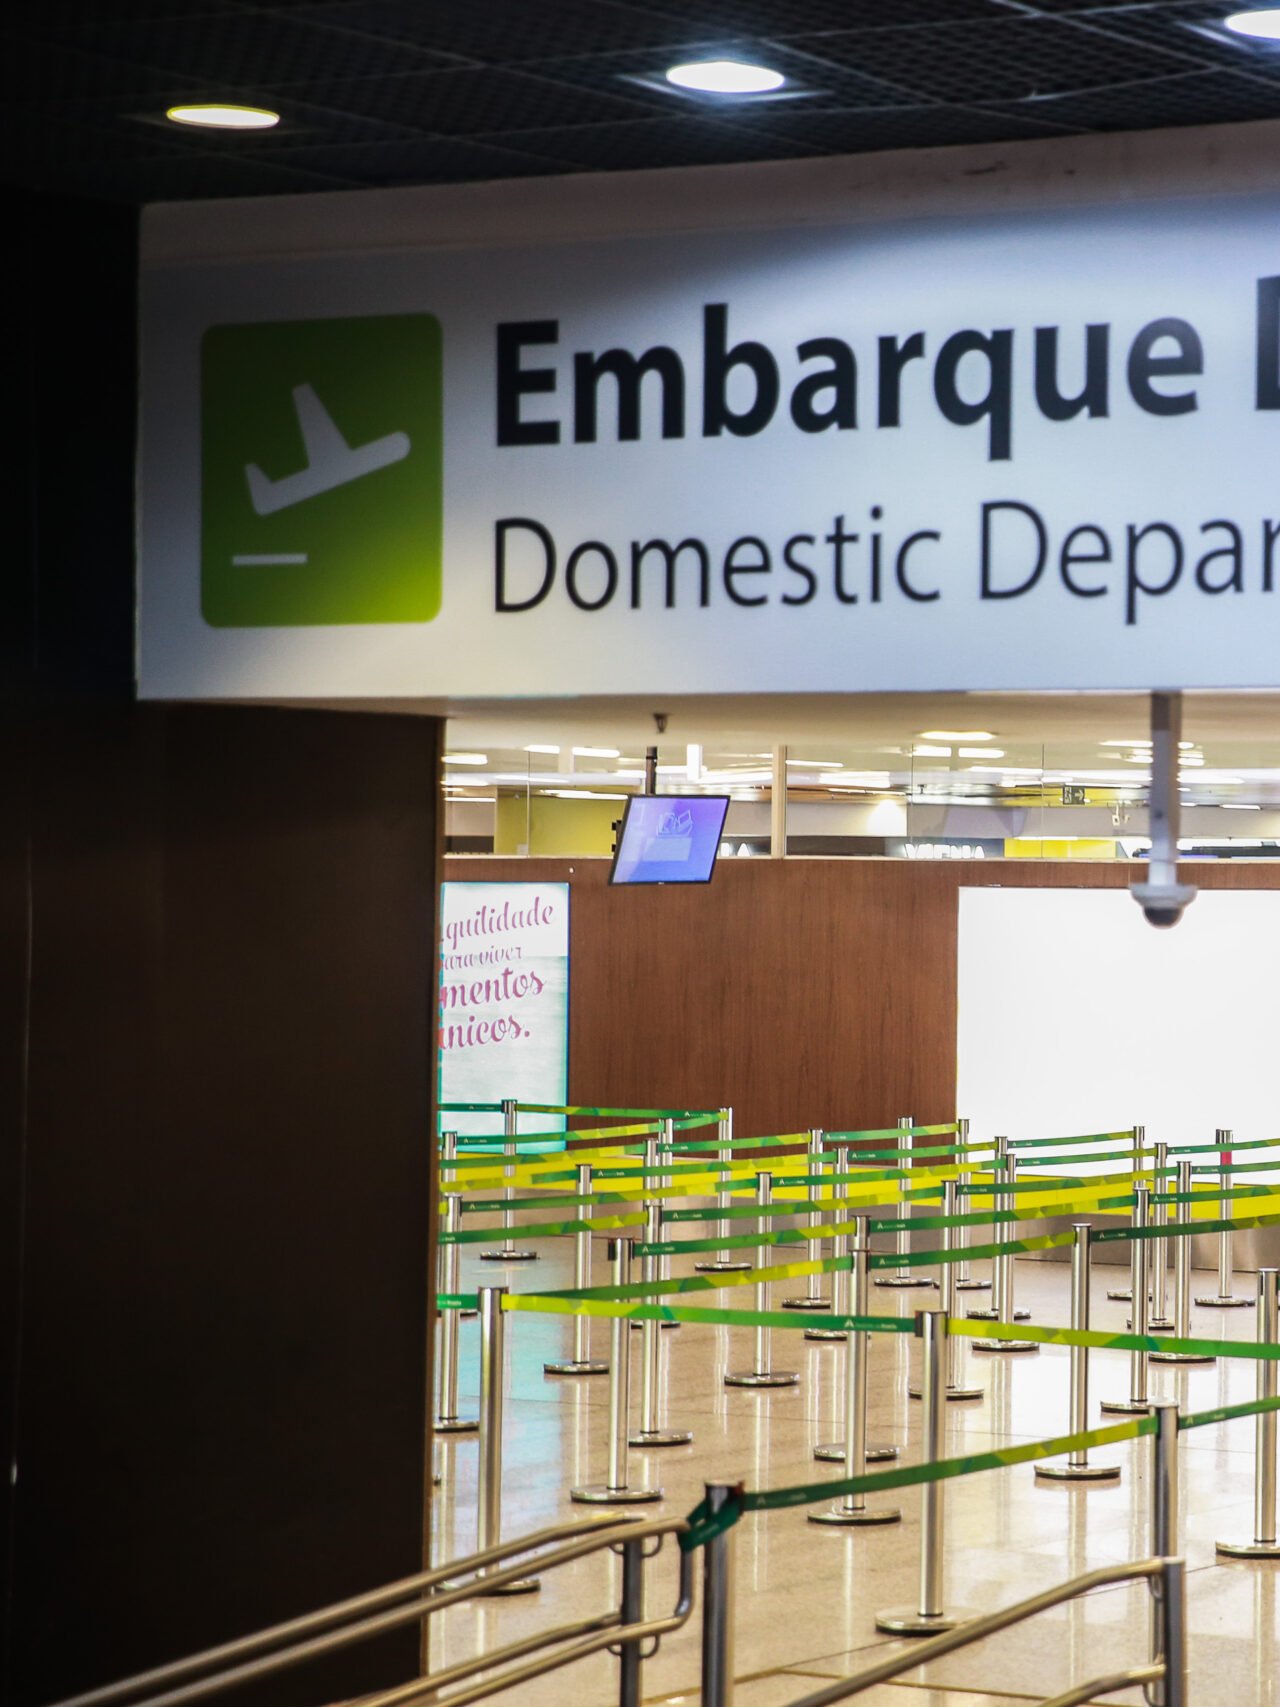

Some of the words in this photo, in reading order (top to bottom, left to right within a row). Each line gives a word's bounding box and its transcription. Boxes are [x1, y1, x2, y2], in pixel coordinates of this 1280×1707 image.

[496, 302, 1203, 462] Embarque
[495, 504, 940, 613] Domestic
[439, 953, 473, 970] ara
[441, 896, 554, 950] quilidade
